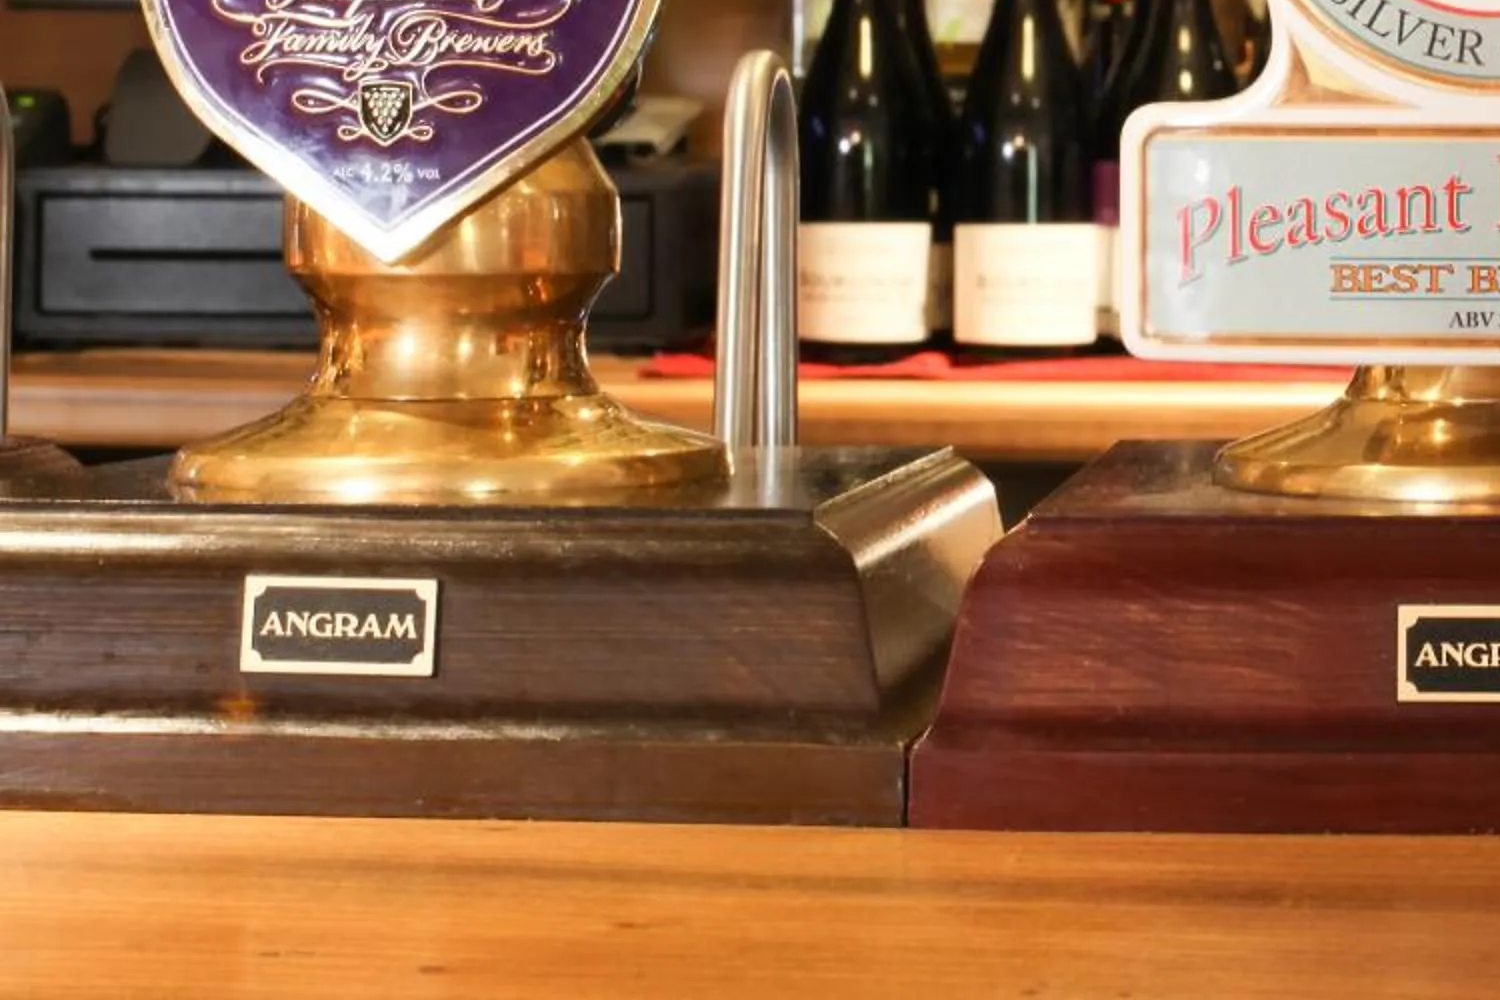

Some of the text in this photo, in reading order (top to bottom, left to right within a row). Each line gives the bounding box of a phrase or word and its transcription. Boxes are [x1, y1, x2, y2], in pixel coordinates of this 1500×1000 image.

[240, 12, 555, 80] Family Brewers
[360, 161, 414, 184] 4.2%
[417, 168, 441, 180] VOL
[1176, 172, 1473, 287] Pleasant
[1329, 263, 1455, 294] BEST
[1448, 310, 1495, 329] ABV
[259, 610, 418, 640] ANGRAM
